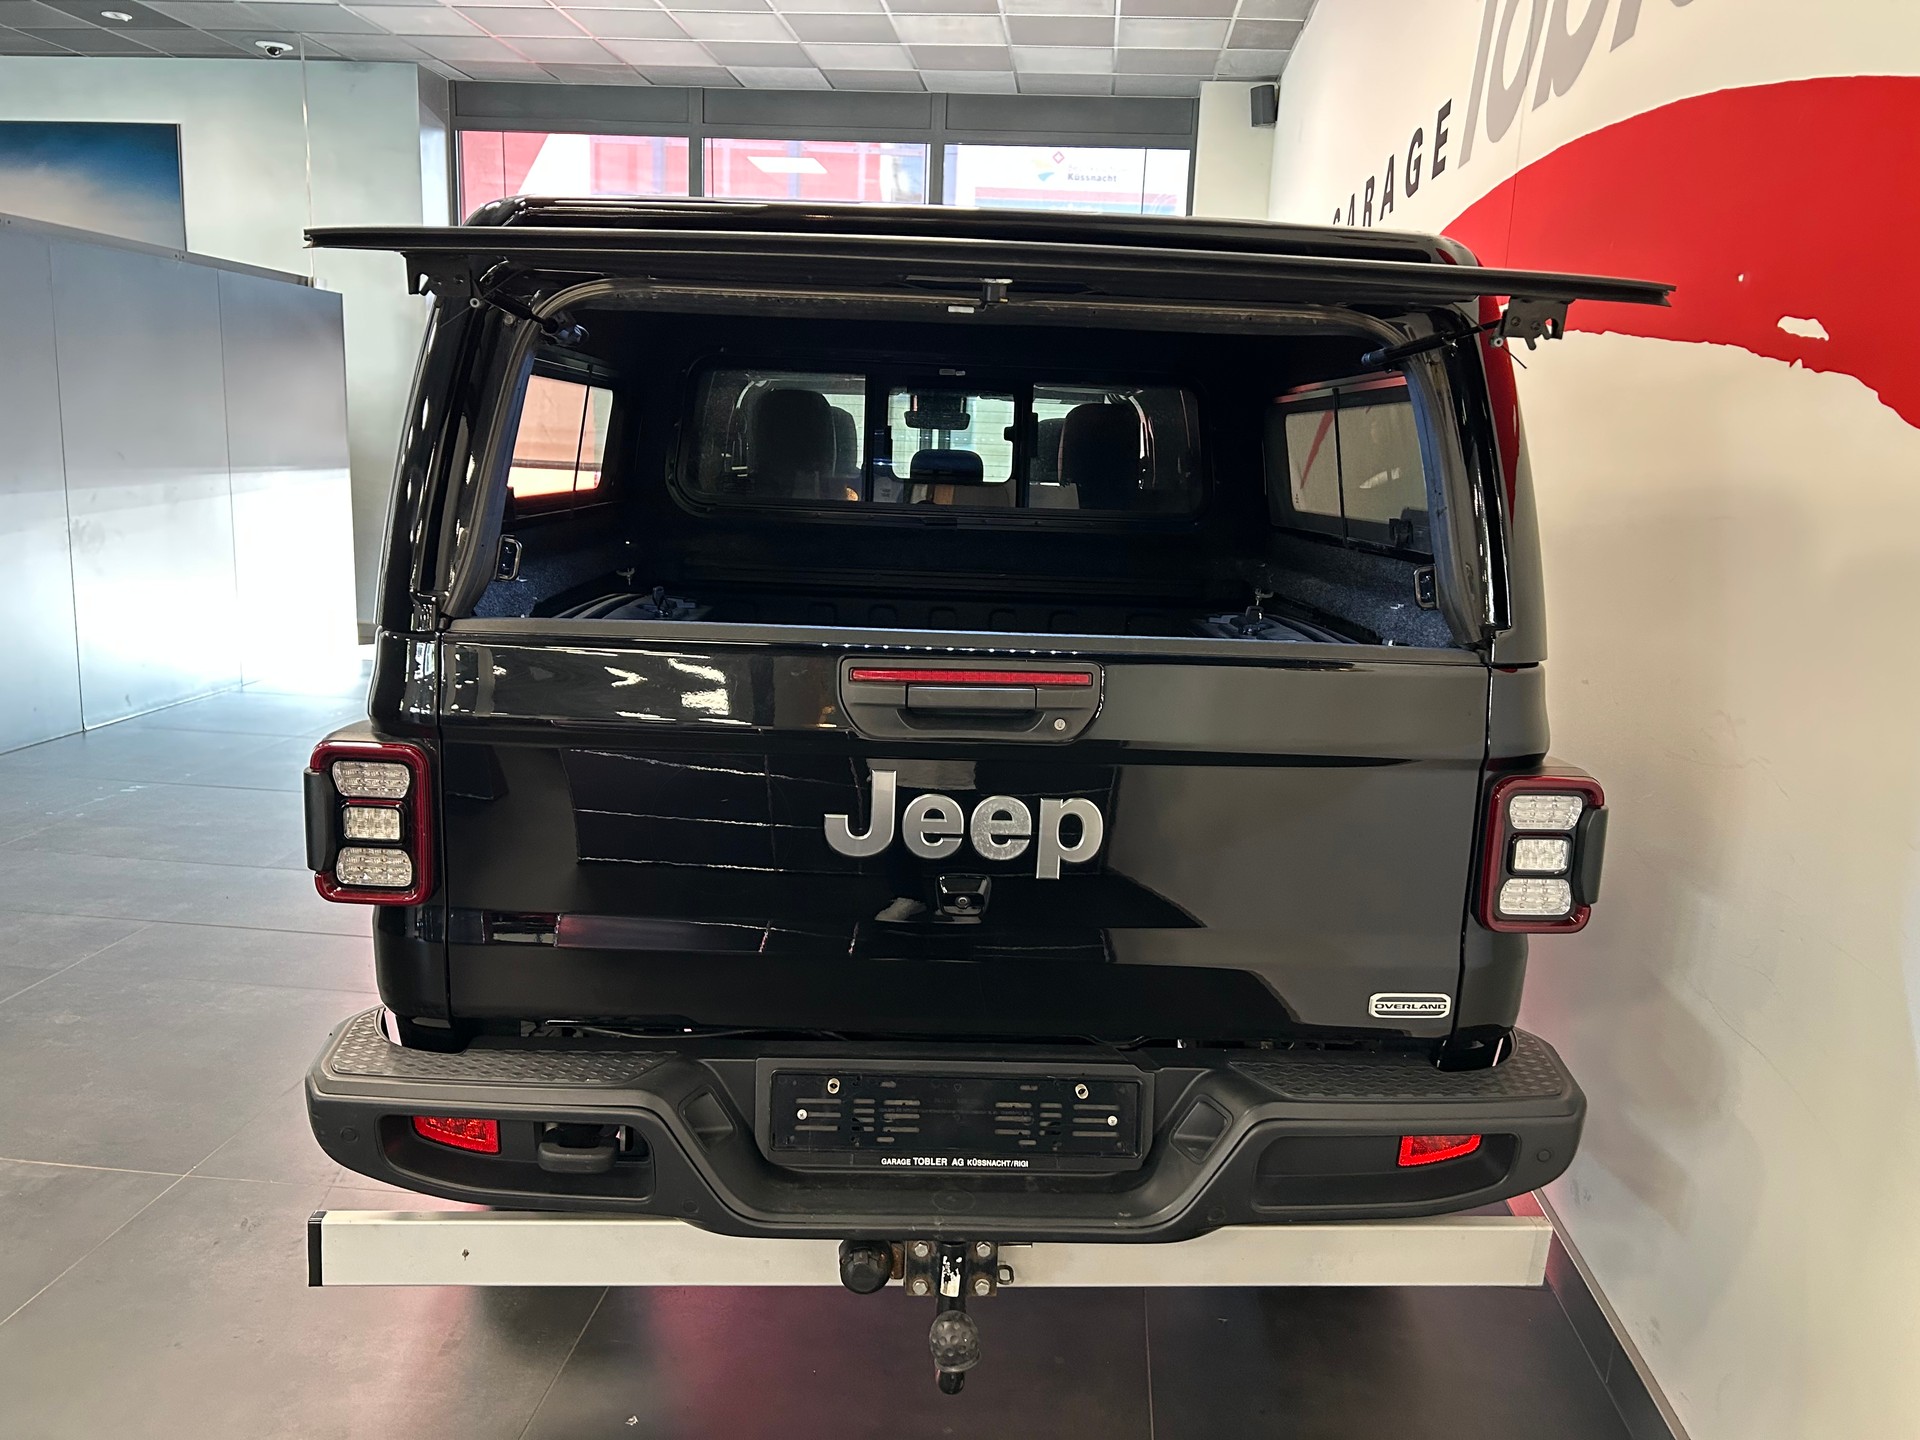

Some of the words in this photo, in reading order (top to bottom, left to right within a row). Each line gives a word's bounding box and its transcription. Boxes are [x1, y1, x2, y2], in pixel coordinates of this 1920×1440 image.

[823, 769, 1104, 880] Jeep
[880, 1158, 911, 1166] GARAGE
[913, 1157, 948, 1166] TOBLER
[951, 1158, 965, 1167] AG
